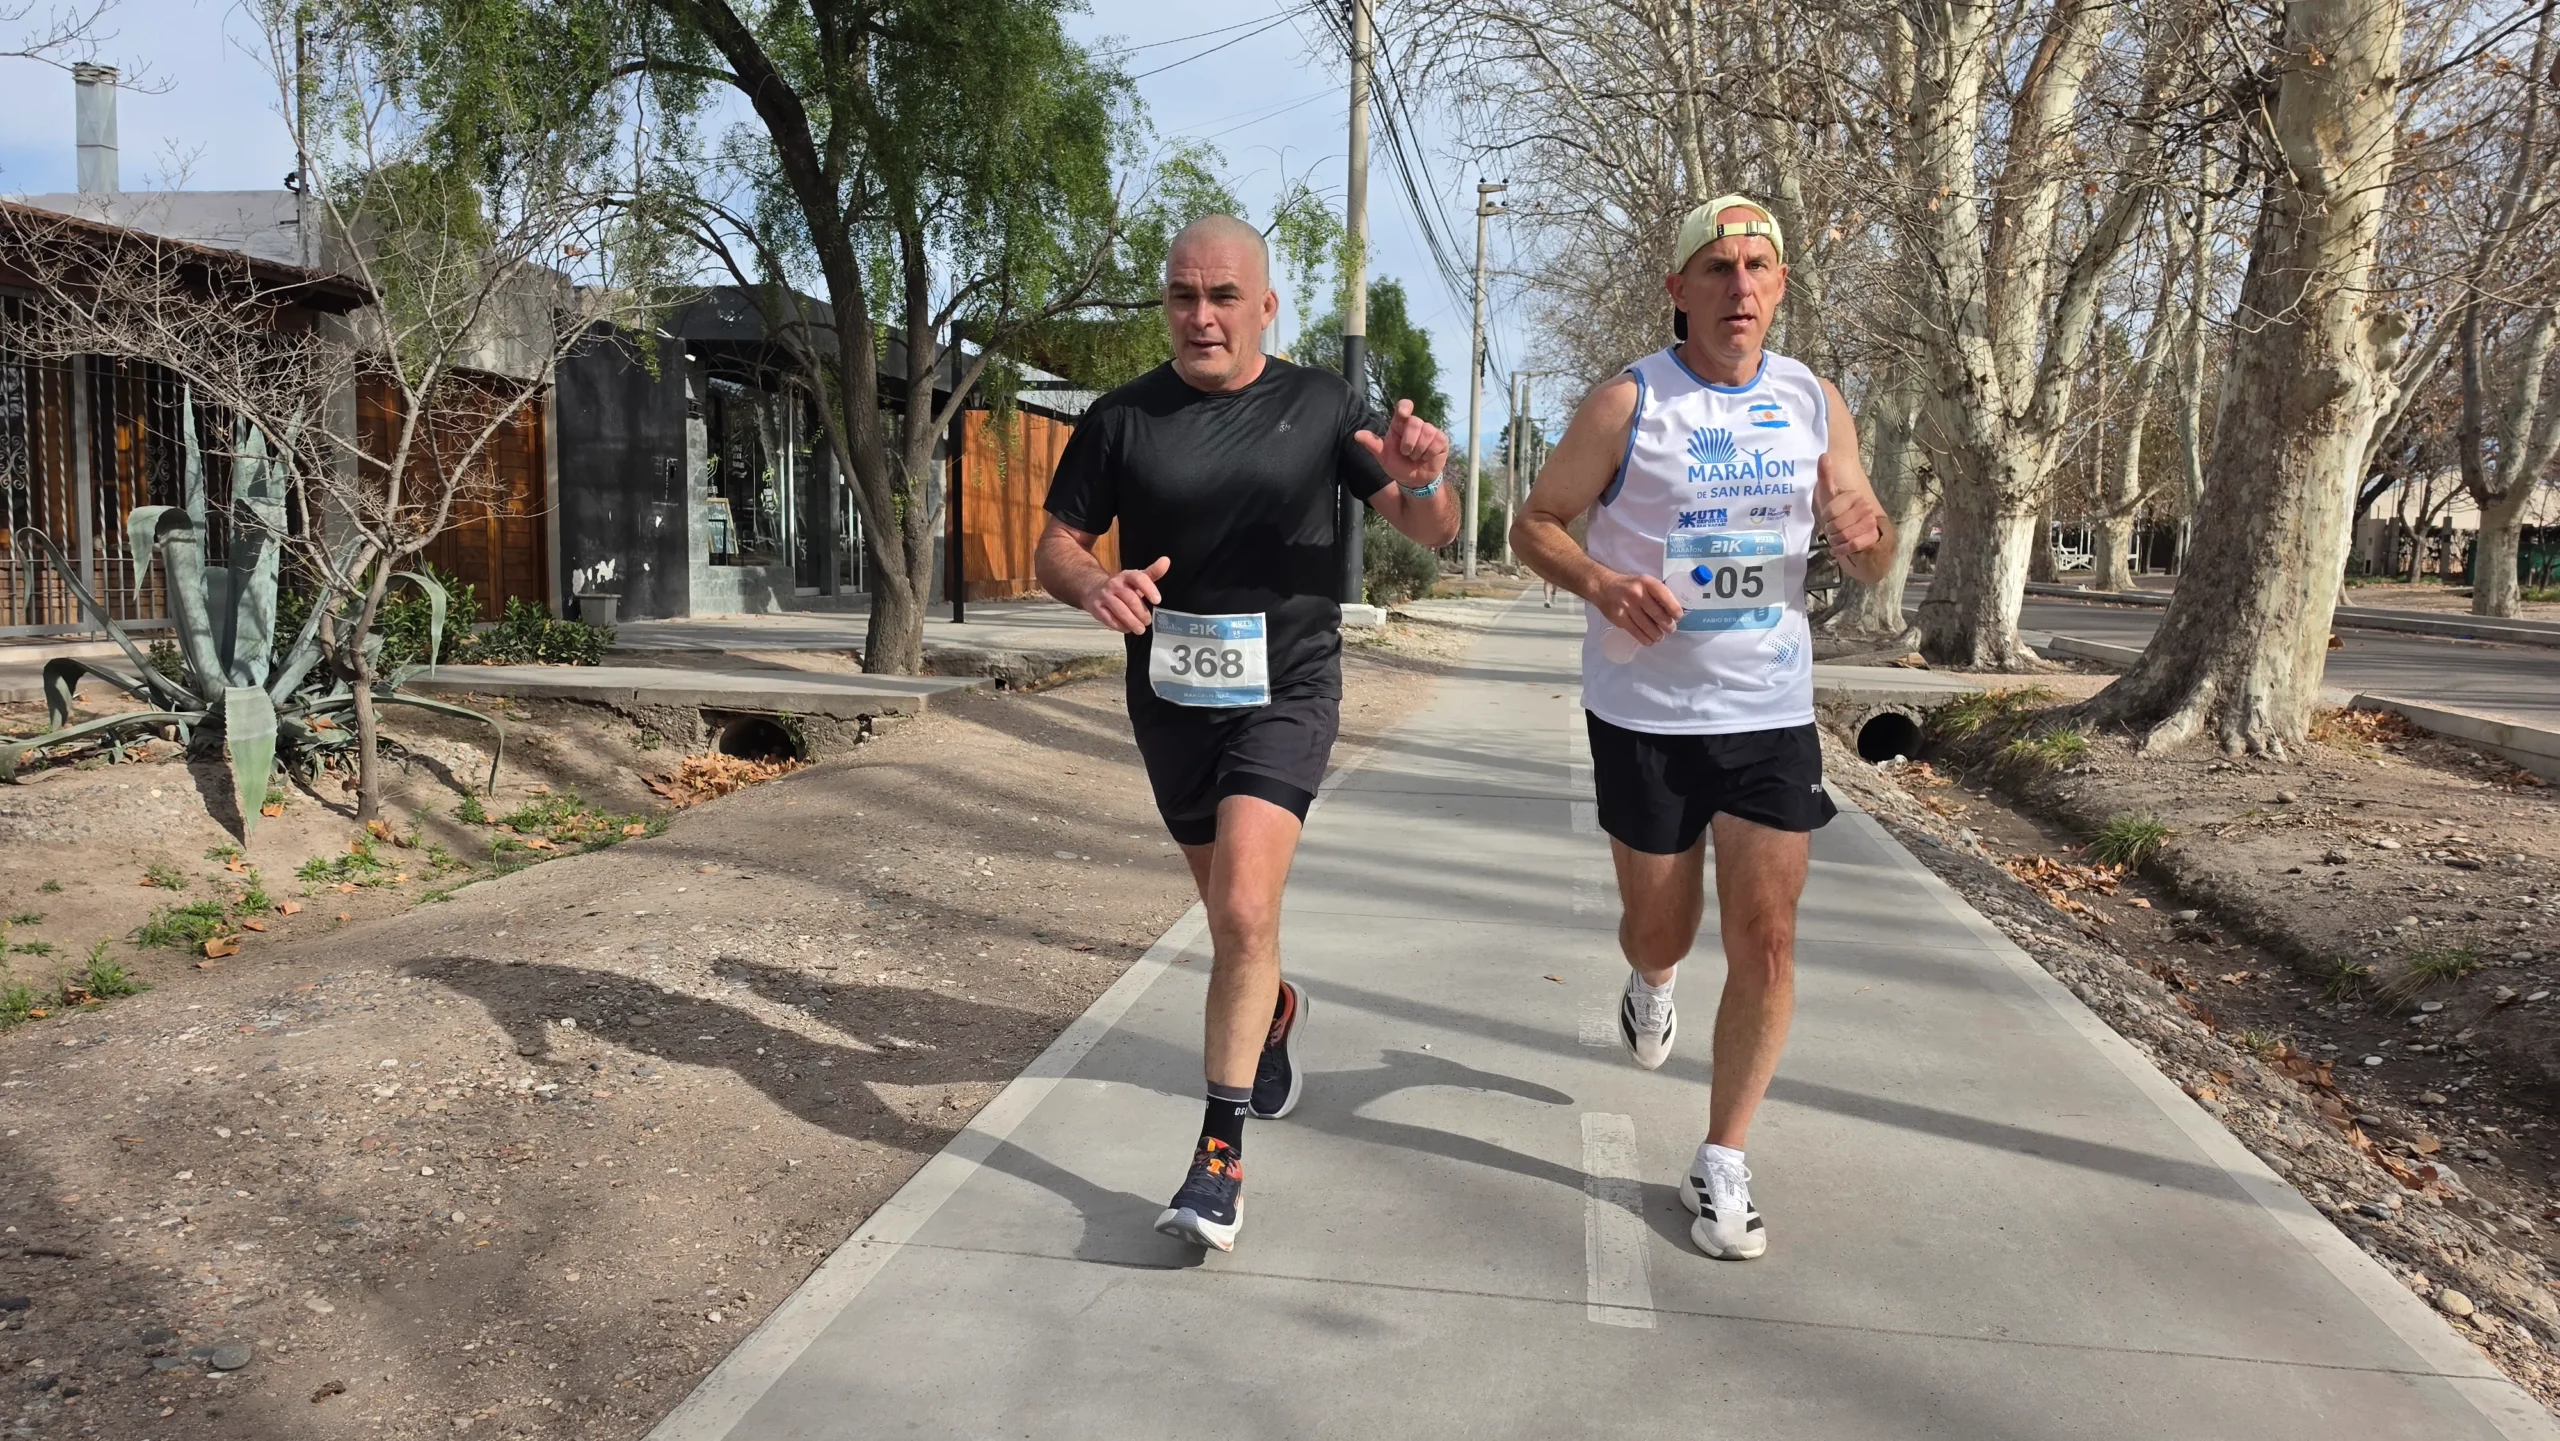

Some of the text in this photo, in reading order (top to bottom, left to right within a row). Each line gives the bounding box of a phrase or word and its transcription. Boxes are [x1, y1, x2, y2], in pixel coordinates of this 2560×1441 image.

[1688, 456, 1794, 483] MARATON
[1697, 484, 1795, 499] DE SAN RAFAEL
[1697, 508, 1728, 519] UTN
[1710, 540, 1743, 553] 21K
[1702, 566, 1764, 599] 05
[1189, 623, 1218, 636] 21K
[1169, 644, 1244, 679] 368
